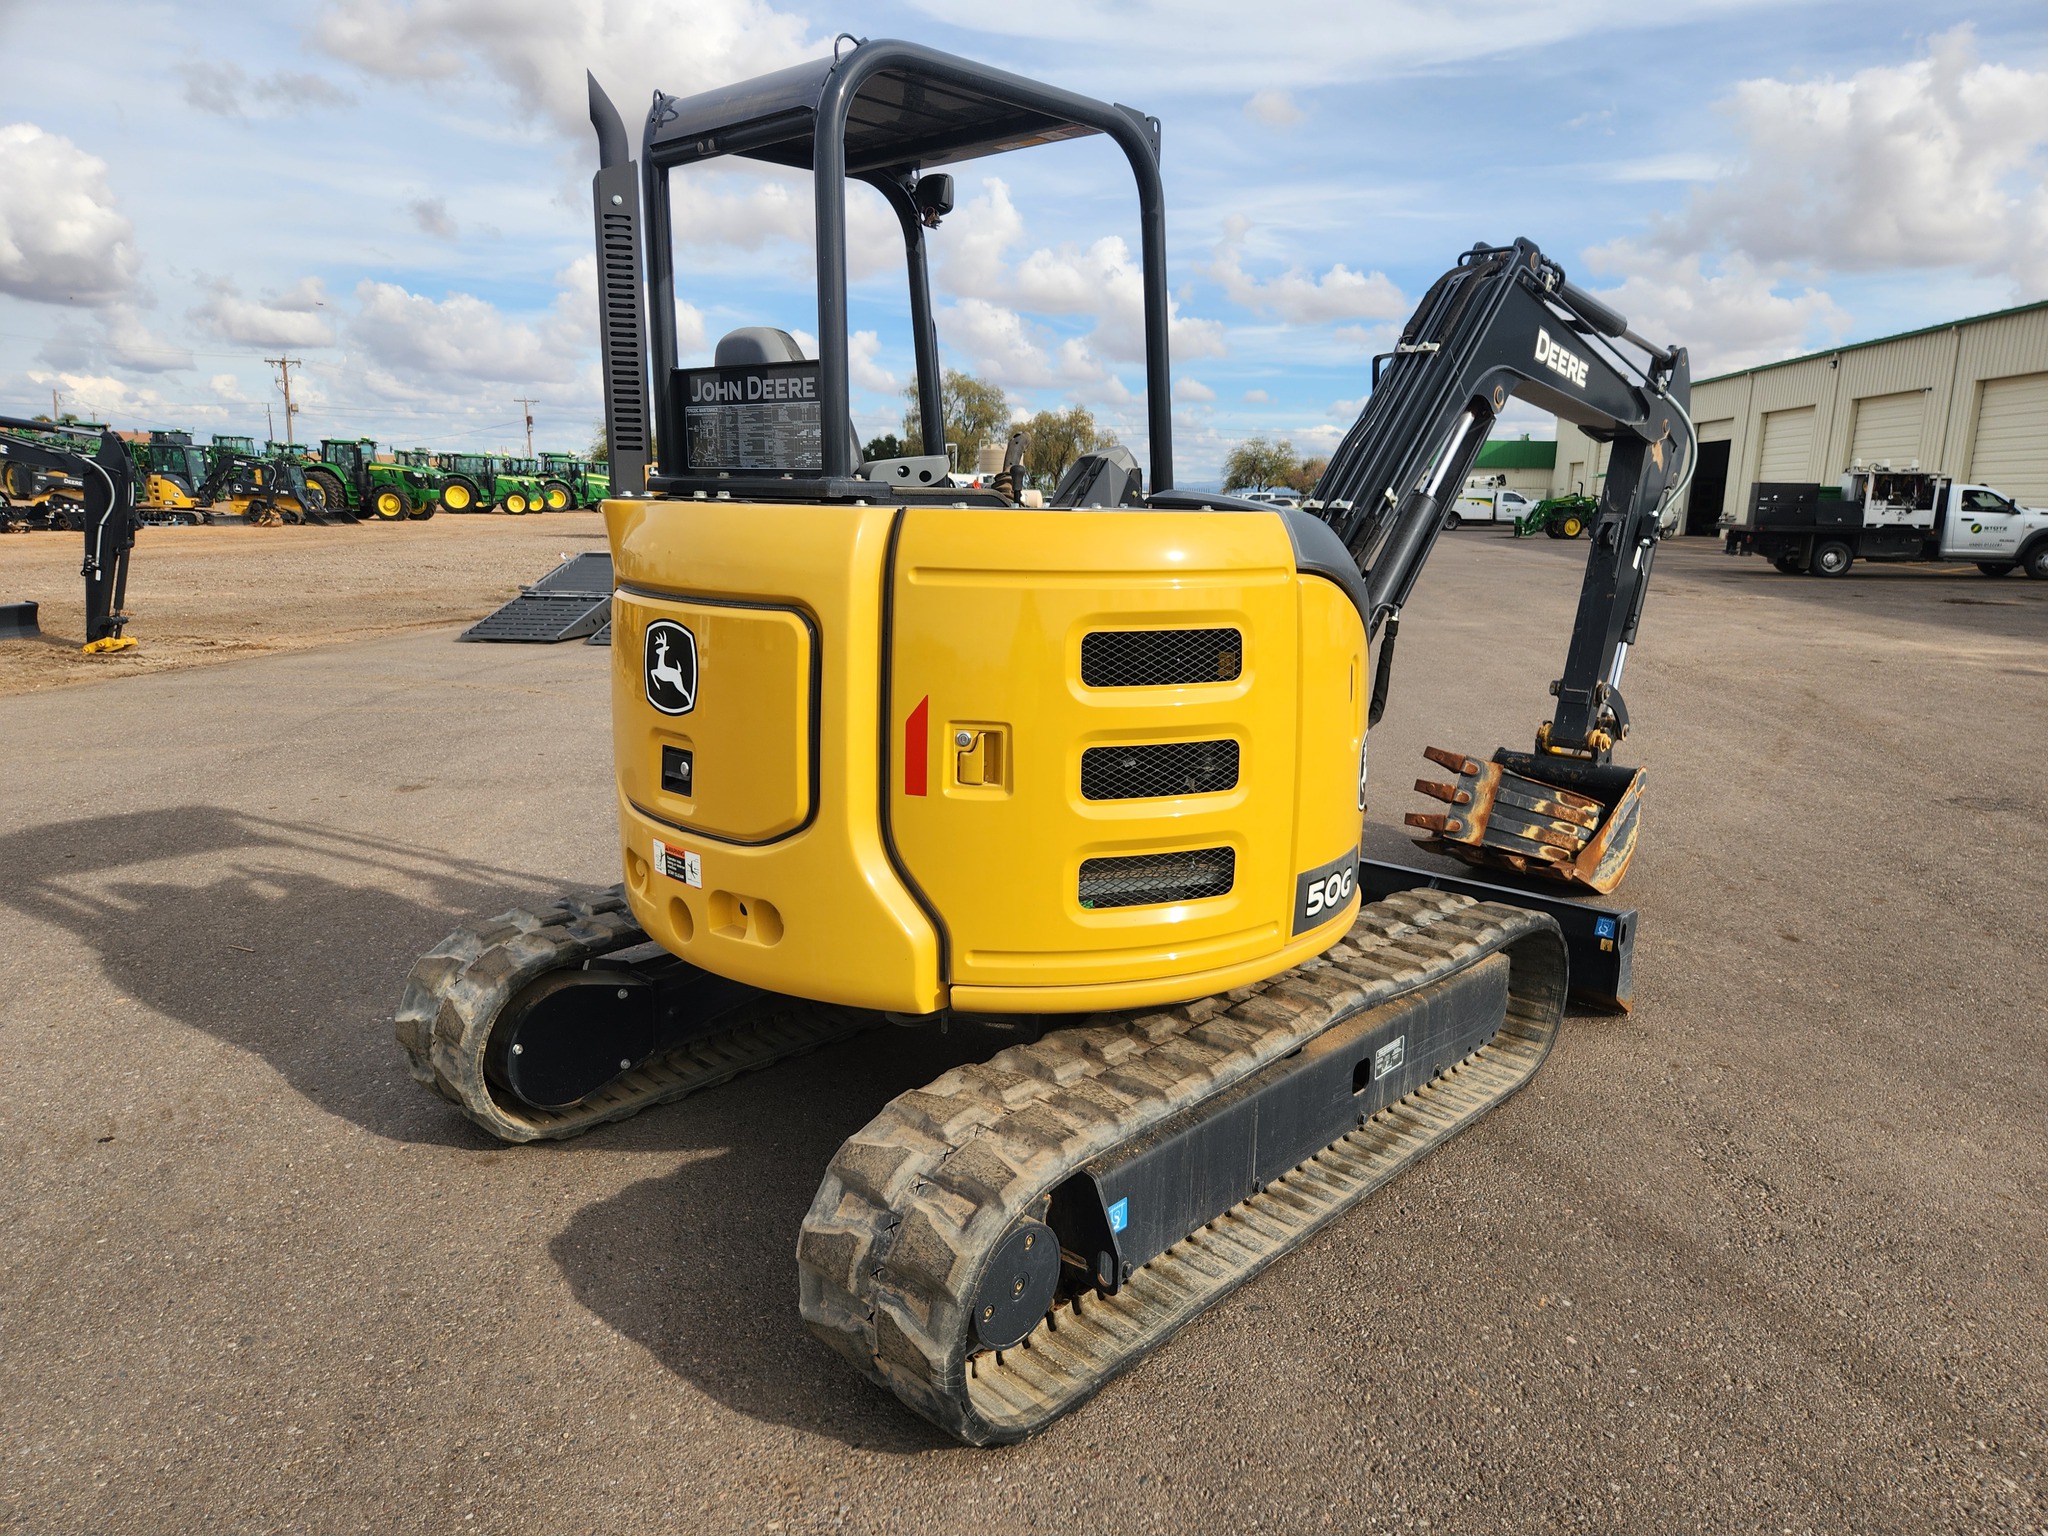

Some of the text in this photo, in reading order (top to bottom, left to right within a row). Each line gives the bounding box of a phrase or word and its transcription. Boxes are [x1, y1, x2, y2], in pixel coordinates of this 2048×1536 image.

[1535, 328, 1589, 388] DEERE
[692, 376, 816, 402] JOHN DEERE
[63, 478, 83, 486] DEERE
[1306, 867, 1352, 916] 50G
